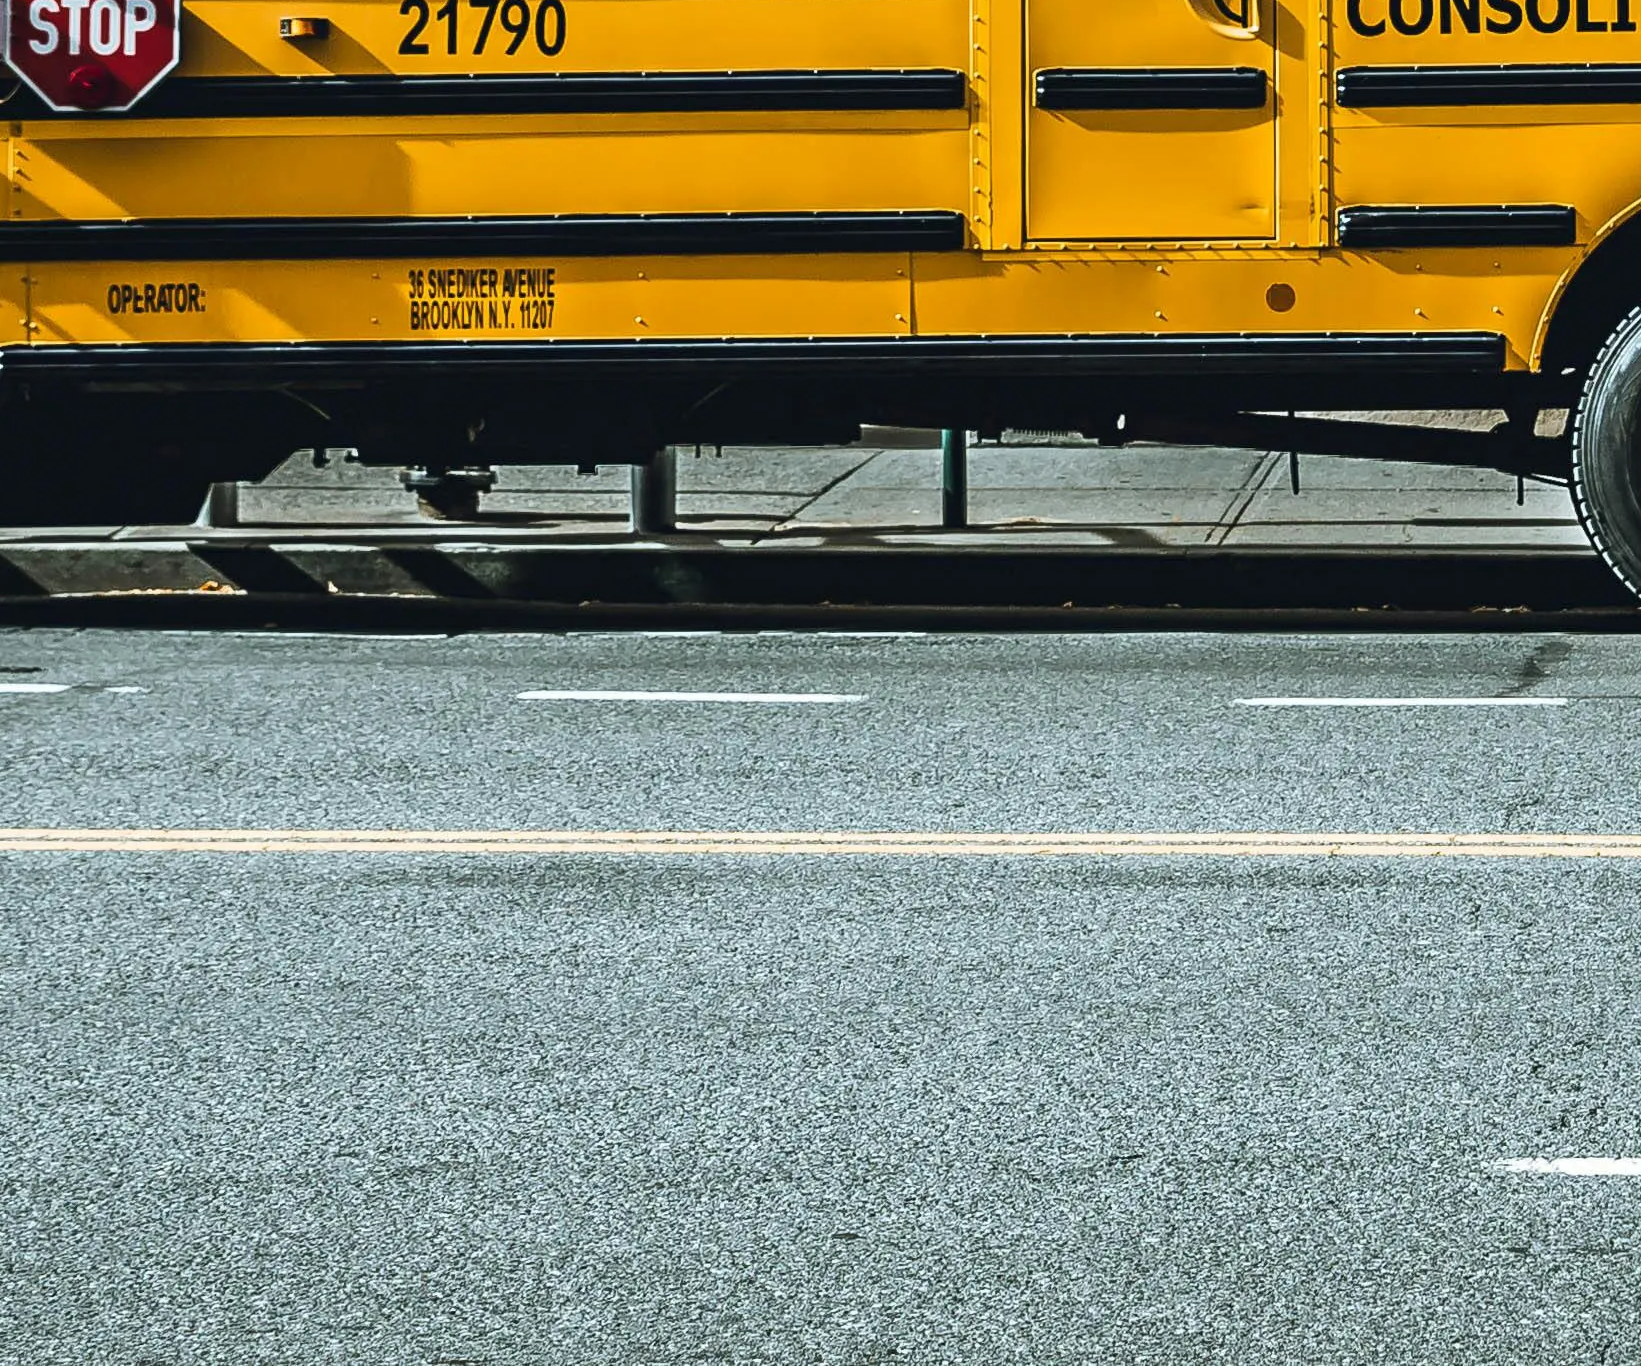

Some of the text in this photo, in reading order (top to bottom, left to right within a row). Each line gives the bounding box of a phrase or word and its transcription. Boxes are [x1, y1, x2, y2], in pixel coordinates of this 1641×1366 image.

[106, 283, 206, 314] OPERATOR:
[408, 268, 555, 299] 36 SNEDIKER AVENUE
[410, 300, 555, 330] BROOKLYN N.Y. 11207
